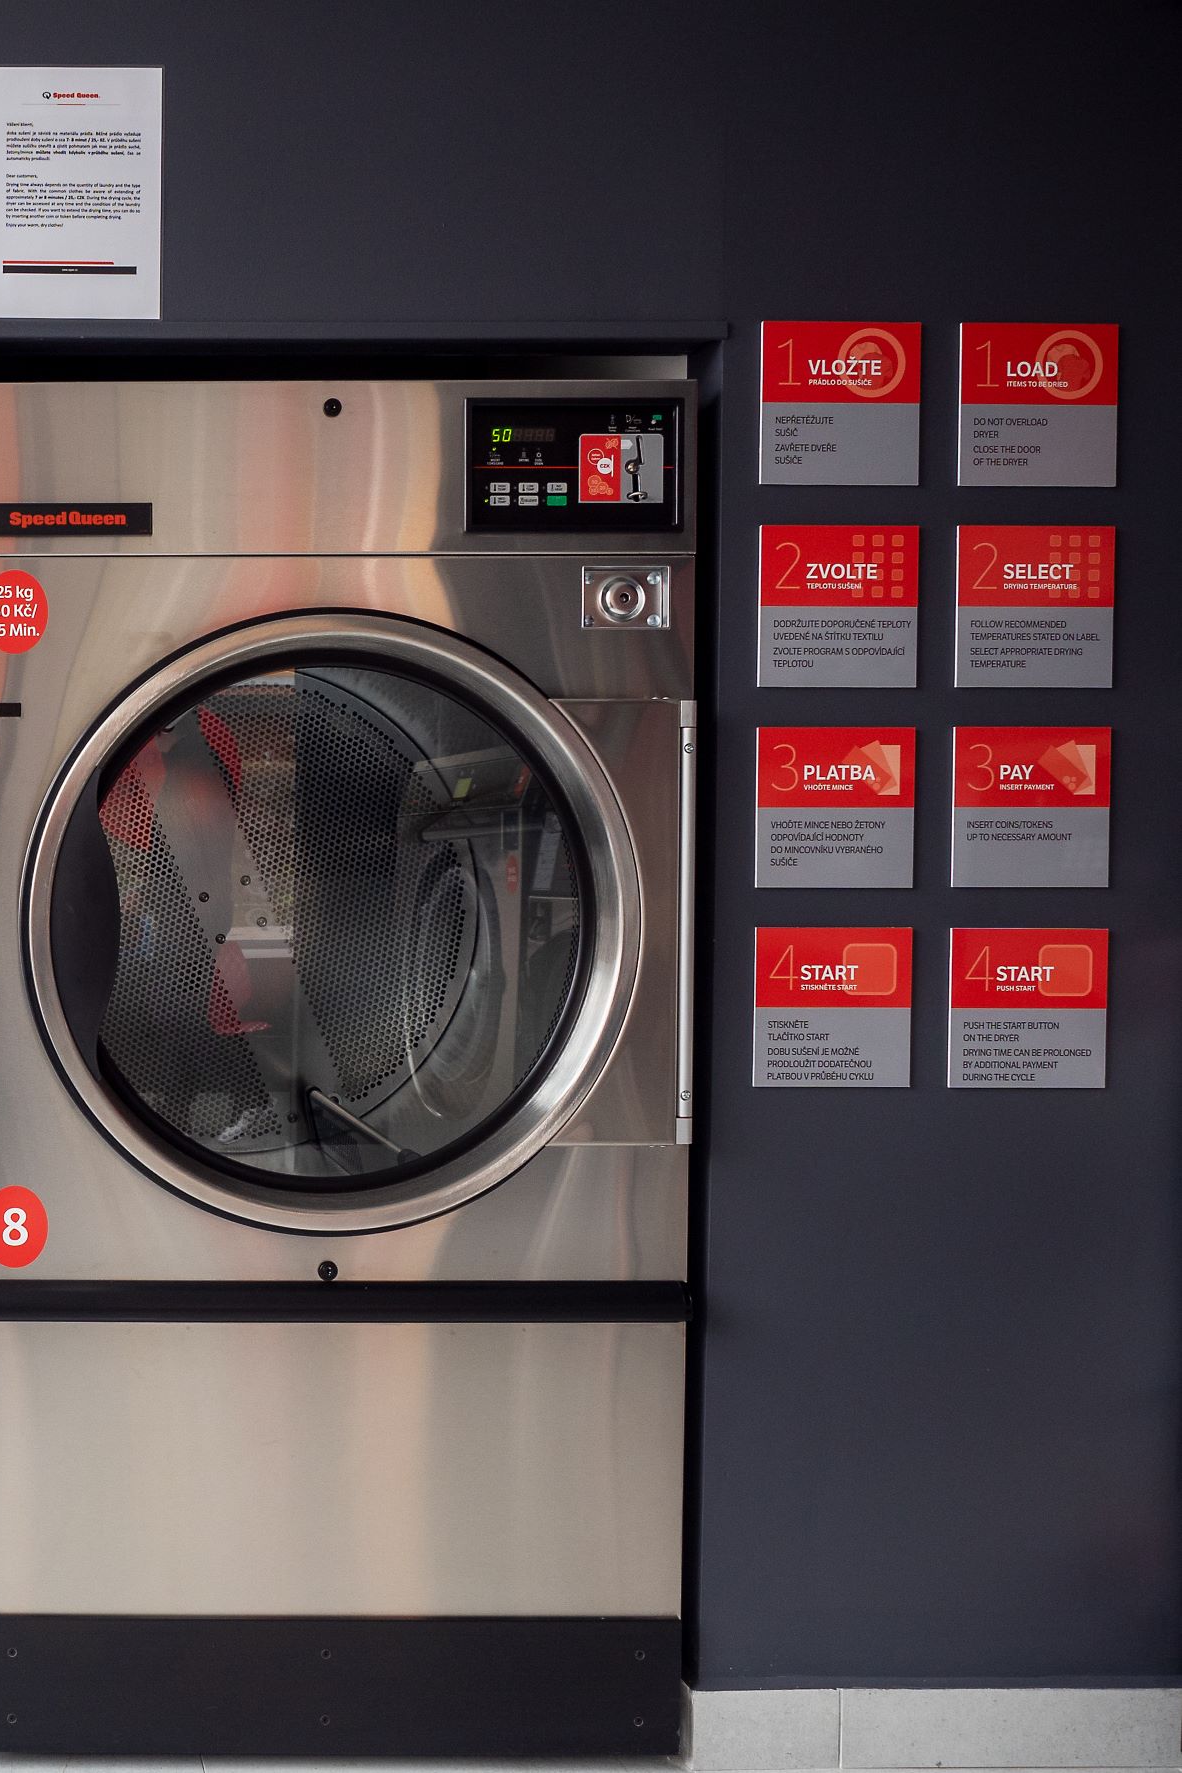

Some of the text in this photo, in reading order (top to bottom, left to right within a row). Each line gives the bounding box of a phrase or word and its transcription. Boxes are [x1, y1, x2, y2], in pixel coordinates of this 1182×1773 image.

[778, 338, 801, 386] 1
[808, 356, 882, 376] VLOŽTE
[976, 340, 1000, 387] 1
[1007, 361, 1058, 377] LOAD
[808, 378, 872, 386] PRÁDLO DO SUŠIČE
[1006, 380, 1027, 388] ITEMS
[1028, 380, 1038, 388] TO
[1038, 380, 1048, 388] BE
[974, 417, 1048, 426] DO NOT OVERLOAD
[492, 428, 512, 442] 50
[775, 427, 798, 437] SUŠIČ
[973, 430, 999, 438] DRYER
[774, 442, 837, 452] ZAVŘETE DVEŘE
[972, 445, 1041, 454] CLOSE THE DOOR
[774, 454, 803, 464] SUŠIČE
[973, 458, 1028, 466] OF THE DRYER
[9, 511, 127, 528] Speed Queen
[775, 542, 801, 589] 2
[972, 542, 998, 590] 2
[806, 563, 878, 579] ZVOLTE
[1003, 564, 1074, 580] SELECT
[806, 582, 862, 590] TEPLOTU SUŠENÍ
[16, 585, 33, 602] kg
[14, 604, 38, 618] Kč/
[773, 618, 912, 629] DODRŽUJTE DOPORUČENÉ TEPLOTY
[970, 620, 1067, 629] FOLLOW RECOMMENDED
[9, 623, 40, 636] Min.
[773, 630, 884, 641] UVEDENÉ NA ŠTÍTKU TEXTILU
[970, 632, 1101, 642] TEMPERATURES STATED ON LABEL
[773, 647, 802, 656] ZVOLTE
[803, 647, 844, 656] PROGRAM
[844, 647, 850, 656] S
[970, 647, 1083, 656] SELECT APPROPRIATE DRYING
[772, 659, 814, 668] TEPLOTOU
[970, 660, 1026, 668] TEMPERATURE
[771, 744, 799, 792] 3
[966, 744, 995, 791] 3
[1000, 764, 1034, 780] PAY
[804, 765, 876, 781] PLATBA
[804, 821, 830, 829] MINCE
[830, 820, 853, 829] NEBO
[854, 820, 886, 829] ŽETONY
[967, 820, 1053, 829] INSERT COINS/TOKENS
[825, 833, 864, 842] HODNOTY
[966, 833, 1072, 841] UP TO NECESSARY AMOUNT
[770, 846, 783, 854] DO
[835, 844, 884, 854] VYBRANÉHO
[770, 856, 798, 866] SUŠIČE
[769, 944, 799, 991] 4
[800, 964, 859, 981] START
[964, 946, 995, 992] 4
[996, 966, 1055, 982] START
[837, 982, 858, 991] START
[768, 1019, 809, 1029] STISKNĚTE
[963, 1021, 1060, 1030] PUSH THE START BUTTON
[768, 1032, 830, 1041] TLAČÍTKO START
[963, 1033, 1020, 1042] ON THE DRYER
[767, 1046, 860, 1056] DOBU SUŠENÍ JE MOŽNÉ
[963, 1048, 1092, 1057] DRYING TIME CAN BE PROLONGED
[767, 1058, 872, 1068] PRODLOUŽIT DODATEČNOU
[962, 1060, 1058, 1069] BY ADDITIONAL PAYMENT
[767, 1070, 874, 1081] PLATBOU V PRŮBĚHU CYKLU
[962, 1073, 1035, 1082] DURING THE CYCLE
[2, 1207, 29, 1246] 8
